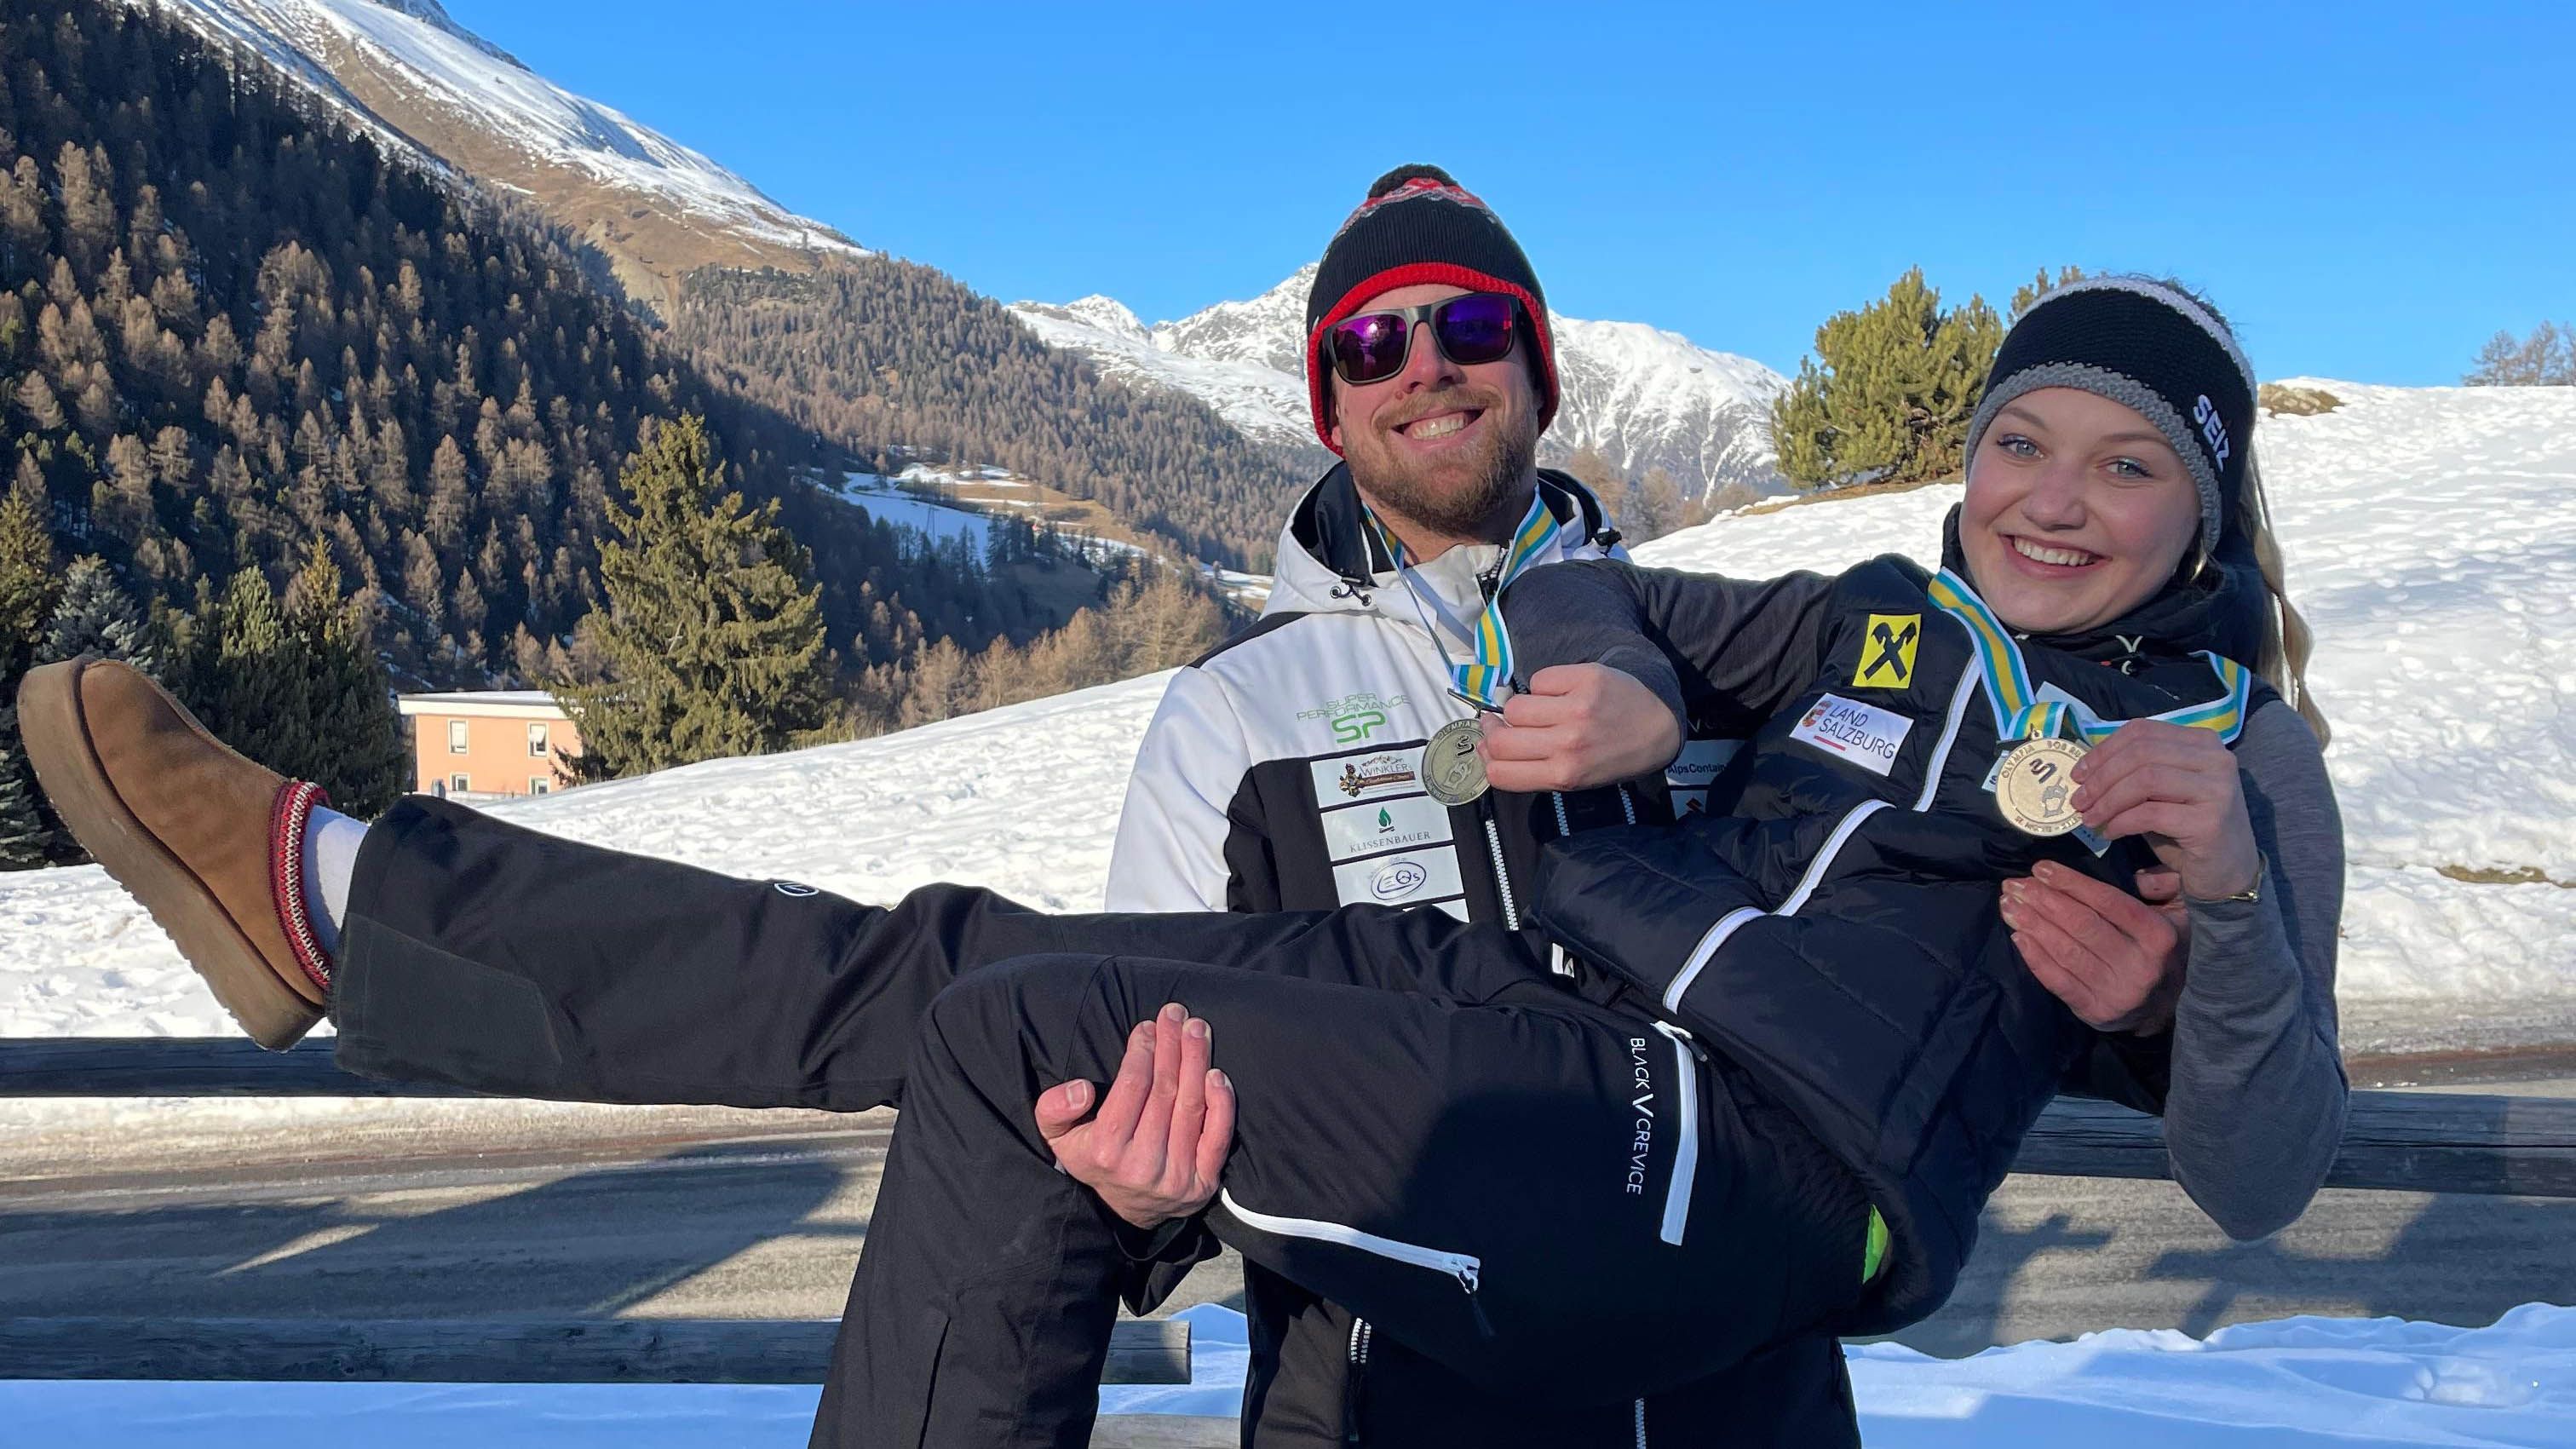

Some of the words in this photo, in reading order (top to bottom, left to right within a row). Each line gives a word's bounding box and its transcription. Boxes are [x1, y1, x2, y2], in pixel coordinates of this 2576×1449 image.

[1296, 695, 1411, 721] PERFORMANCE
[1326, 693, 1377, 709] SUPER
[1331, 711, 1386, 744] SP
[1829, 705, 1868, 727] LAND
[1819, 718, 1896, 759] SALZBURG
[1667, 763, 1728, 776] AlpsContain
[2002, 744, 2035, 779] OLYMPIA
[2047, 740, 2067, 750] BOB
[1350, 831, 1430, 853] KLISSENBAUER
[1630, 1038, 1650, 1090] BLACK
[1627, 1118, 1651, 1194] CREVICE
